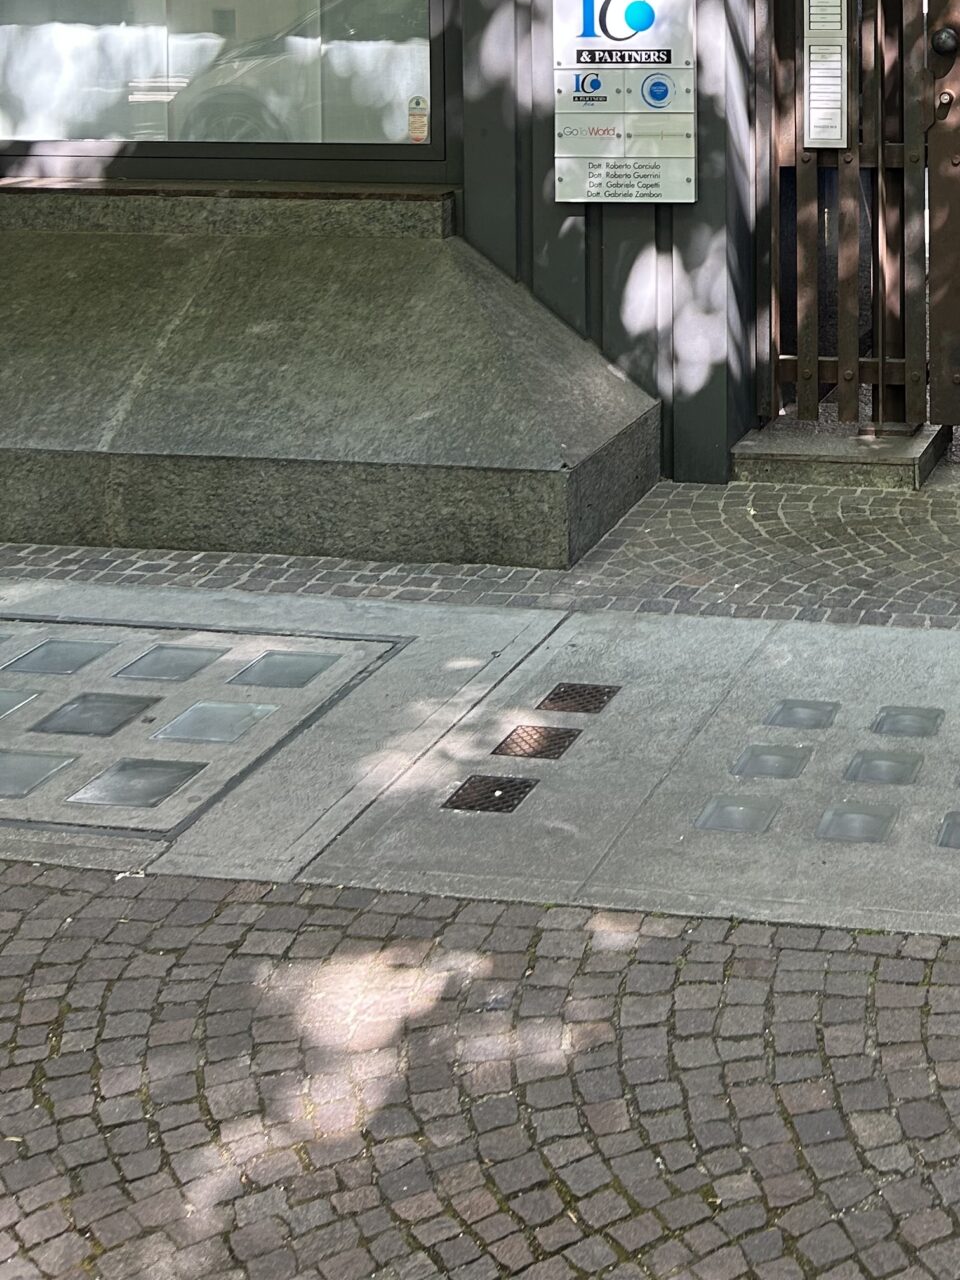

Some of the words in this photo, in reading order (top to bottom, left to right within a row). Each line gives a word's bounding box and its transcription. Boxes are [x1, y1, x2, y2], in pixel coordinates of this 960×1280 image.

[580, 51, 592, 62] &
[595, 50, 668, 63] PARTNERS
[605, 161, 631, 170] Roberto
[605, 171, 631, 179] Roberto
[605, 180, 635, 189] Gabriele
[603, 190, 633, 198] Gabriele
